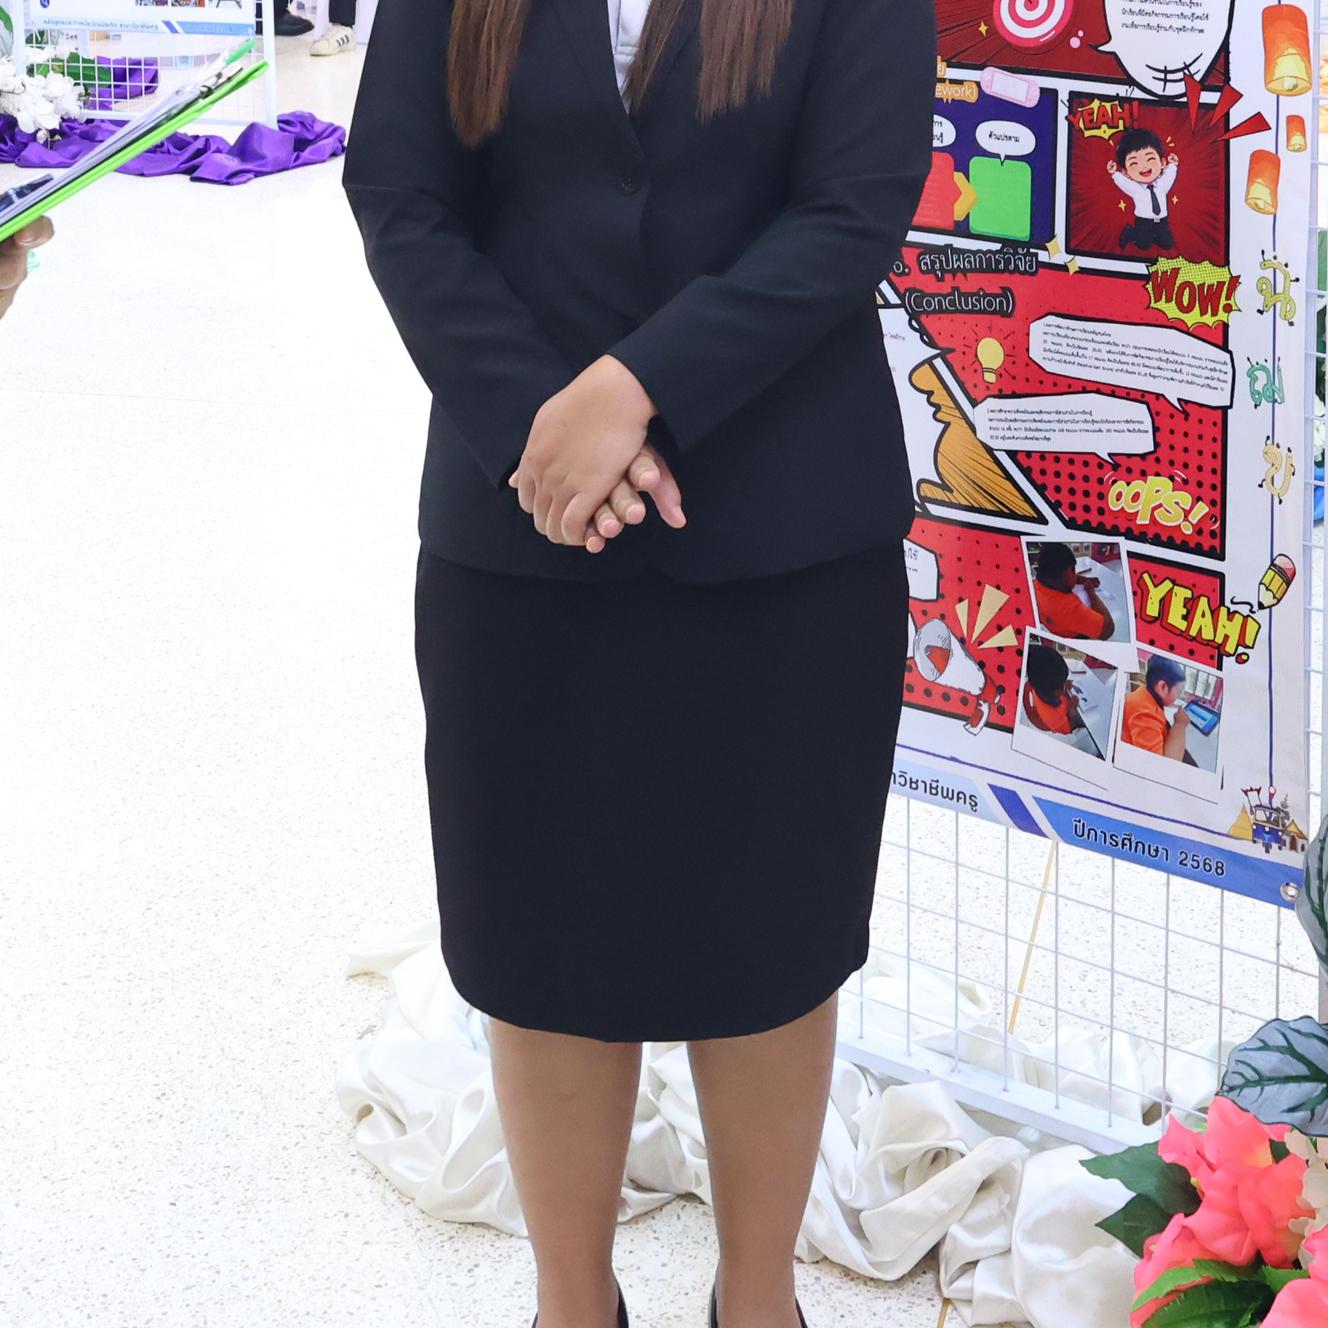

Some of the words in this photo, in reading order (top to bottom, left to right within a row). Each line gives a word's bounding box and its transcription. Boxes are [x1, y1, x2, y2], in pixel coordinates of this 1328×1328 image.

[935, 83, 977, 98] ework)
[1066, 98, 1141, 130] YEAH!
[920, 248, 1036, 277] สรุปผลการวิจัย
[905, 289, 1013, 312] (Conclusion)
[1150, 266, 1241, 317] WOW!
[1108, 476, 1210, 535] OOPS!
[1138, 571, 1261, 665] YEAH!
[890, 768, 979, 813] าวิชาชีพครู
[1073, 818, 1170, 862] ปีการศึกษา
[1178, 851, 1225, 877] 2568
